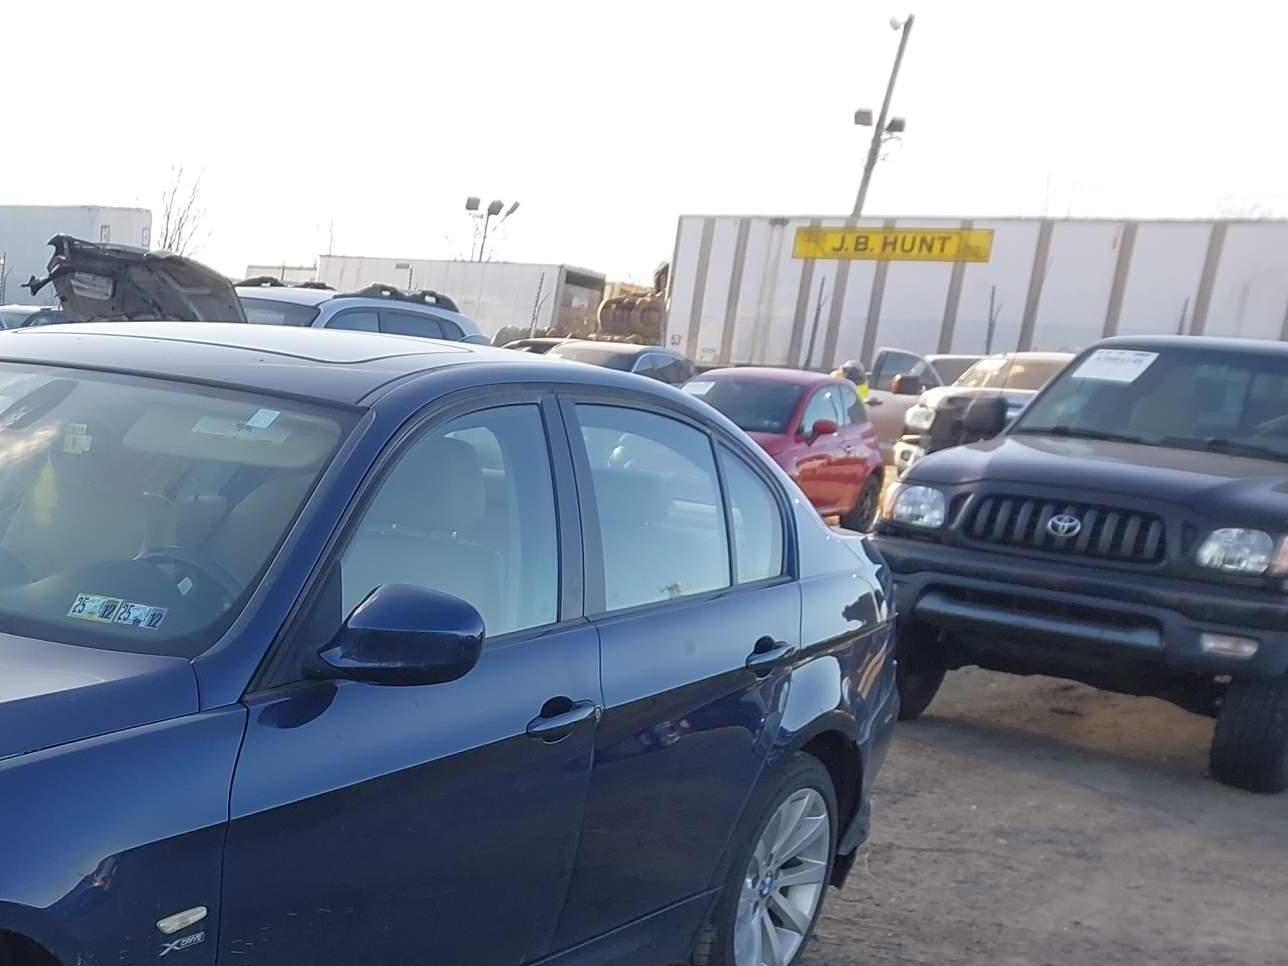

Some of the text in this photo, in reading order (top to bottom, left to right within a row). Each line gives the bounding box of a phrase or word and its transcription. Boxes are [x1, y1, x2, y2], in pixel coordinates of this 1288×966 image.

[831, 234, 953, 254] J.B. HUNT
[72, 596, 90, 614] 25
[118, 604, 164, 628] 25 12
